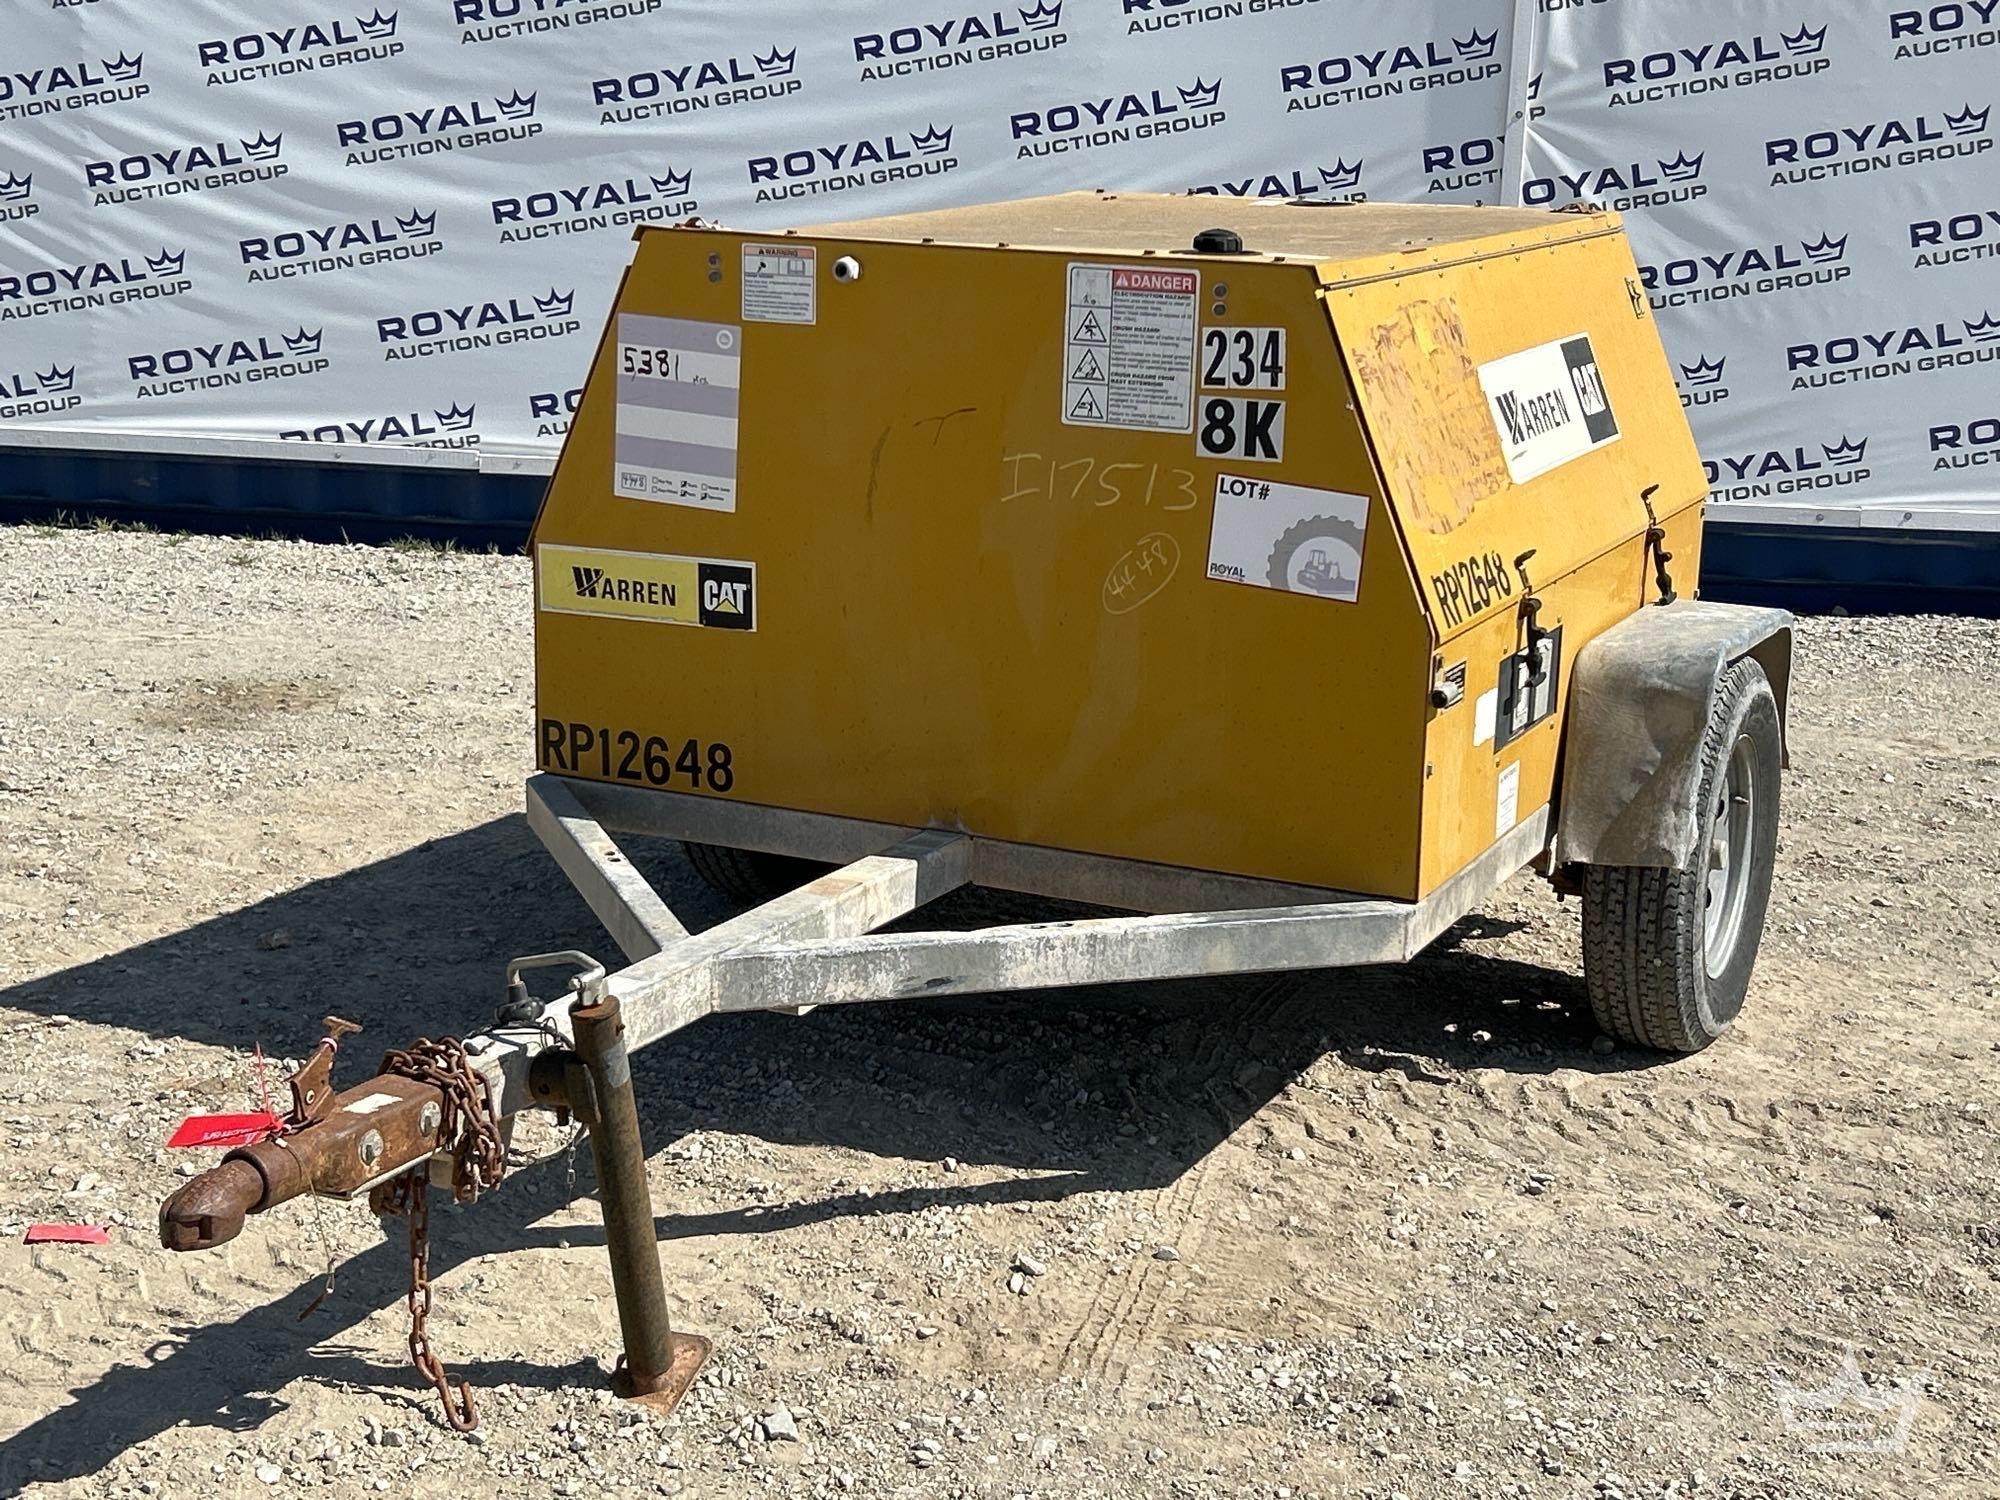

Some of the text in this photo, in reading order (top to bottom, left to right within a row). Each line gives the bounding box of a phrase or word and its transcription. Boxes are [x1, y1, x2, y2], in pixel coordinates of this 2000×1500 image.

[461, 13, 570, 45] AUCTION
[574, 0, 662, 25] GROUP
[853, 11, 1020, 62] ROYAL
[1127, 1, 1243, 35] AUCTION
[1889, 0, 2000, 40] ROY
[197, 20, 359, 68] ROYAL
[206, 42, 405, 87] AUCTION GROUP
[860, 33, 1068, 82] AUCTION GROUP
[1603, 36, 1781, 88] ROYAL
[1894, 29, 2000, 61] AUCTIO
[0, 62, 105, 101] YAL
[592, 58, 756, 106] ROYAL
[1280, 41, 1453, 93] ROYAL
[1286, 62, 1502, 114] AUCTION GROUP
[1608, 58, 1831, 108] AUCTION GROUP
[0, 84, 150, 121] TION GROUP
[336, 101, 497, 148] ROYAL
[600, 79, 802, 126] AUCTION GROUP
[1010, 89, 1178, 140] ROYAL
[345, 122, 543, 167] AUCTION GROUP
[1016, 111, 1226, 160] AUCTION GROUP
[1765, 116, 1944, 167] ROYAL
[84, 142, 243, 188] ROYAL
[747, 136, 912, 184] ROYAL
[755, 157, 958, 204] AUCTION GROUP
[1427, 162, 1504, 194] AUCT
[1769, 138, 1994, 187] AUCTION GROUP
[93, 164, 289, 207] AUCTION GROUP
[491, 179, 652, 225] ROYAL
[1196, 170, 1319, 198] YAL
[1522, 163, 1658, 206] OYAL
[1613, 184, 1708, 212] GROUP
[239, 219, 398, 265] ROYAL
[499, 200, 698, 244] AUCTION GROUP
[247, 241, 443, 283] AUCTION GROUP
[1914, 242, 2000, 269] AUCTI
[0, 259, 147, 302] ROYAL
[1, 280, 193, 321] AUCTION GROUP
[1131, 273, 1193, 291] DANGER
[1649, 266, 1851, 310] UCTION GROUP
[376, 299, 535, 343] ROYAL
[384, 320, 581, 362] AUCTION GROUP
[127, 337, 285, 380] ROYAL
[1204, 330, 1283, 388] 234
[1786, 323, 1963, 372] ROYAL
[1791, 346, 2000, 391] AUCTION GROU
[136, 358, 330, 399] AUCTION GROUP
[0, 395, 82, 419] GROUP
[1201, 398, 1282, 459] 8K
[1495, 387, 1571, 445] WARREN
[1933, 449, 2000, 472] AUCT
[1219, 476, 1271, 501] LOT#
[1709, 468, 1871, 503] TION GROUP
[571, 565, 748, 615] WARREN CAT
[1210, 562, 1246, 578] ROYAL
[1430, 549, 1511, 629] RP12648
[541, 718, 734, 793] RP12648
